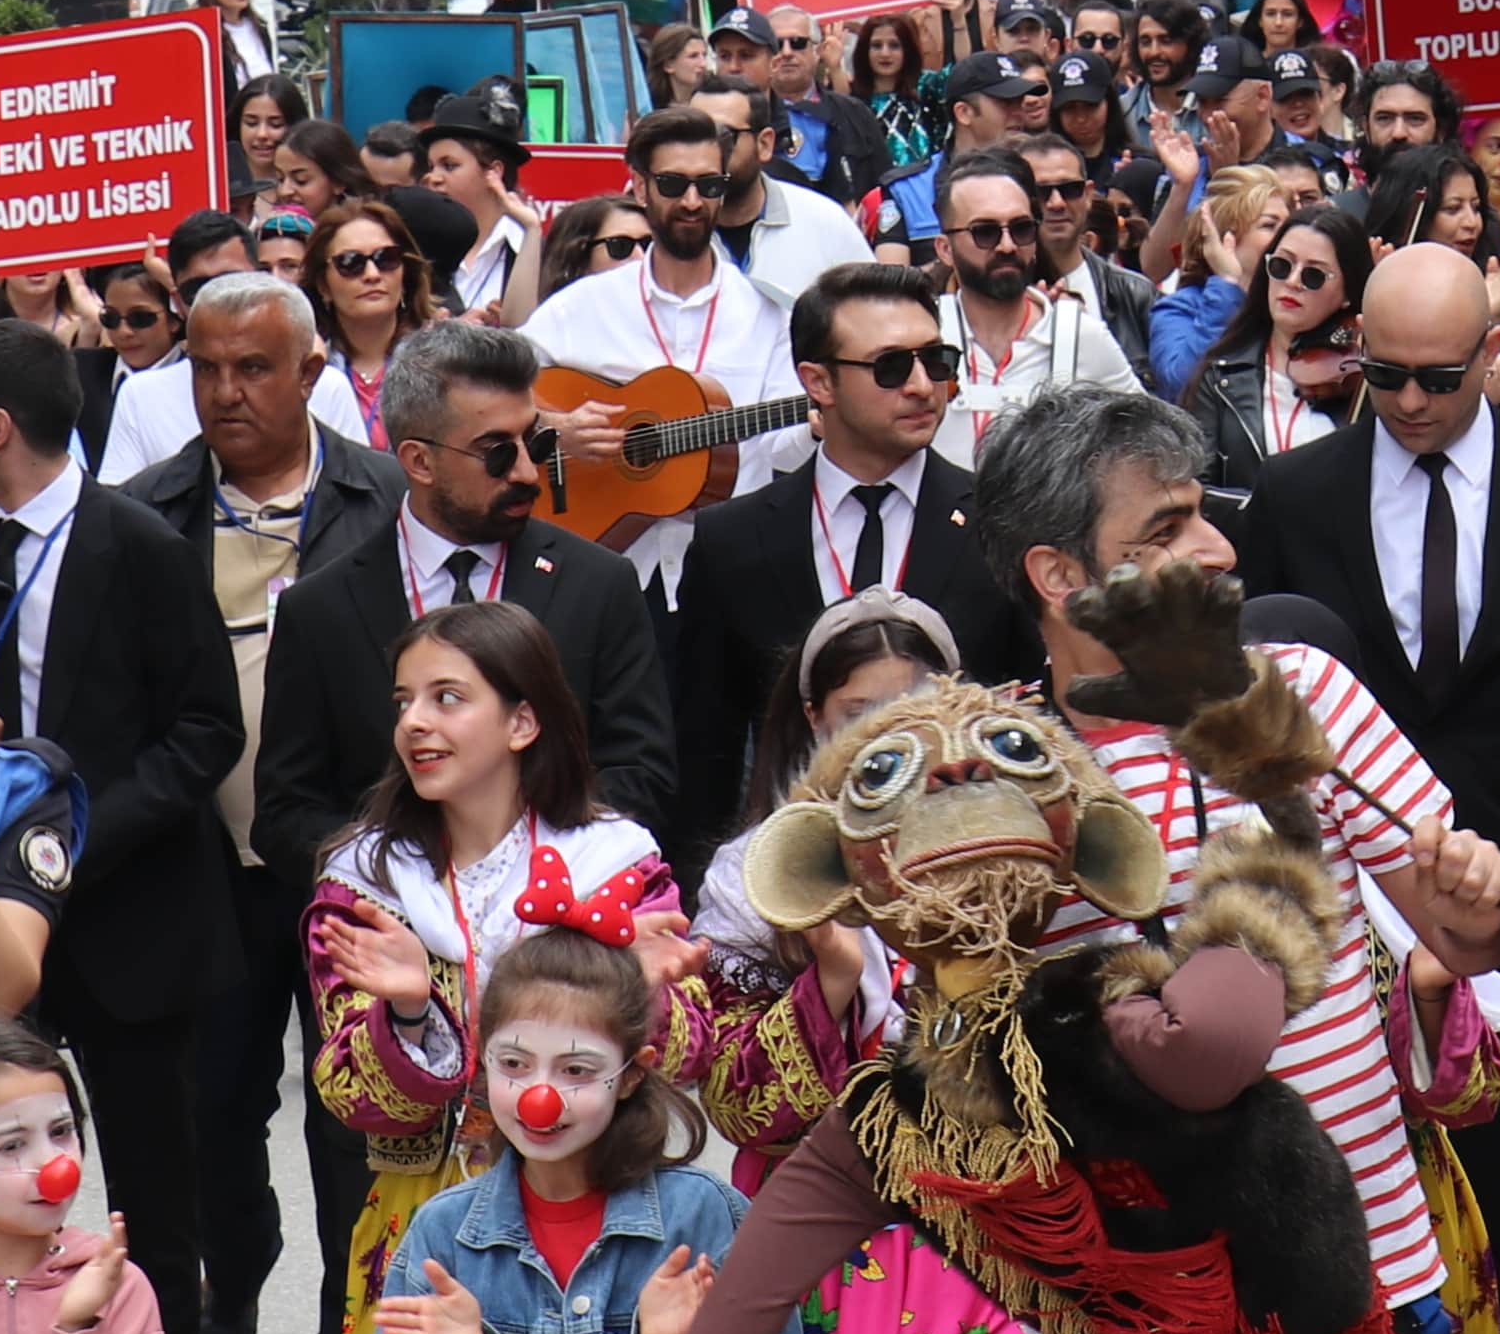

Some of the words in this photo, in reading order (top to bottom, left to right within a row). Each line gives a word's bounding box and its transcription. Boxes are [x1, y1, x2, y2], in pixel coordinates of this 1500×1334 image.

[0, 70, 116, 120] EDREMİT
[49, 135, 85, 168] VE
[91, 115, 193, 163] TEKNİK
[87, 171, 171, 219] LİSESİ
